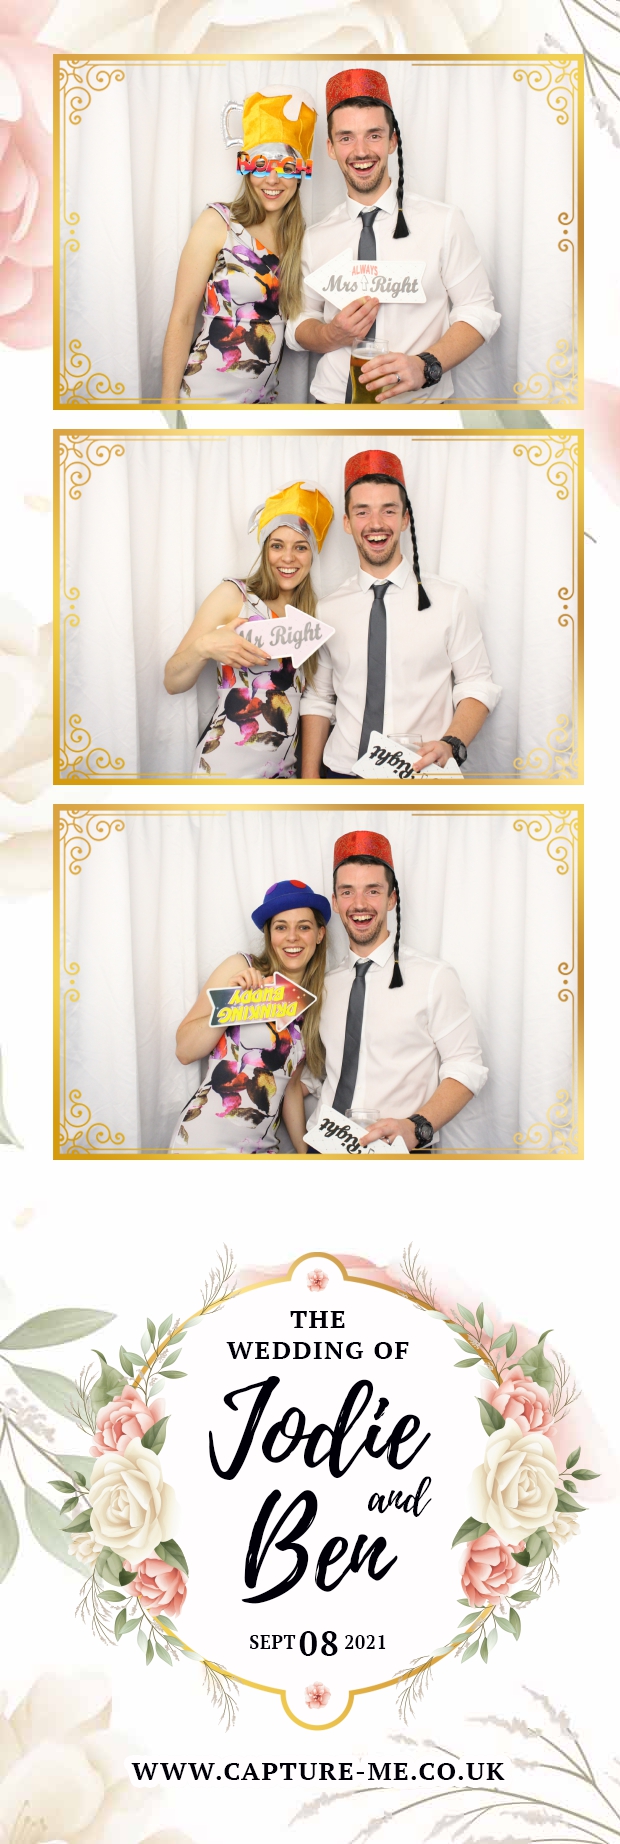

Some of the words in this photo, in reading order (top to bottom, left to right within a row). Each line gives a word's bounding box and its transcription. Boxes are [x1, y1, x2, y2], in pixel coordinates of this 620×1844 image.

[351, 264, 378, 276] ALWAYS
[323, 275, 358, 292] Mrs
[369, 275, 419, 299] Right
[269, 621, 323, 650] Right
[369, 745, 421, 779] Right
[229, 986, 285, 1005] BUDDY
[217, 1001, 298, 1023] DRINKING
[319, 1118, 368, 1154] Right
